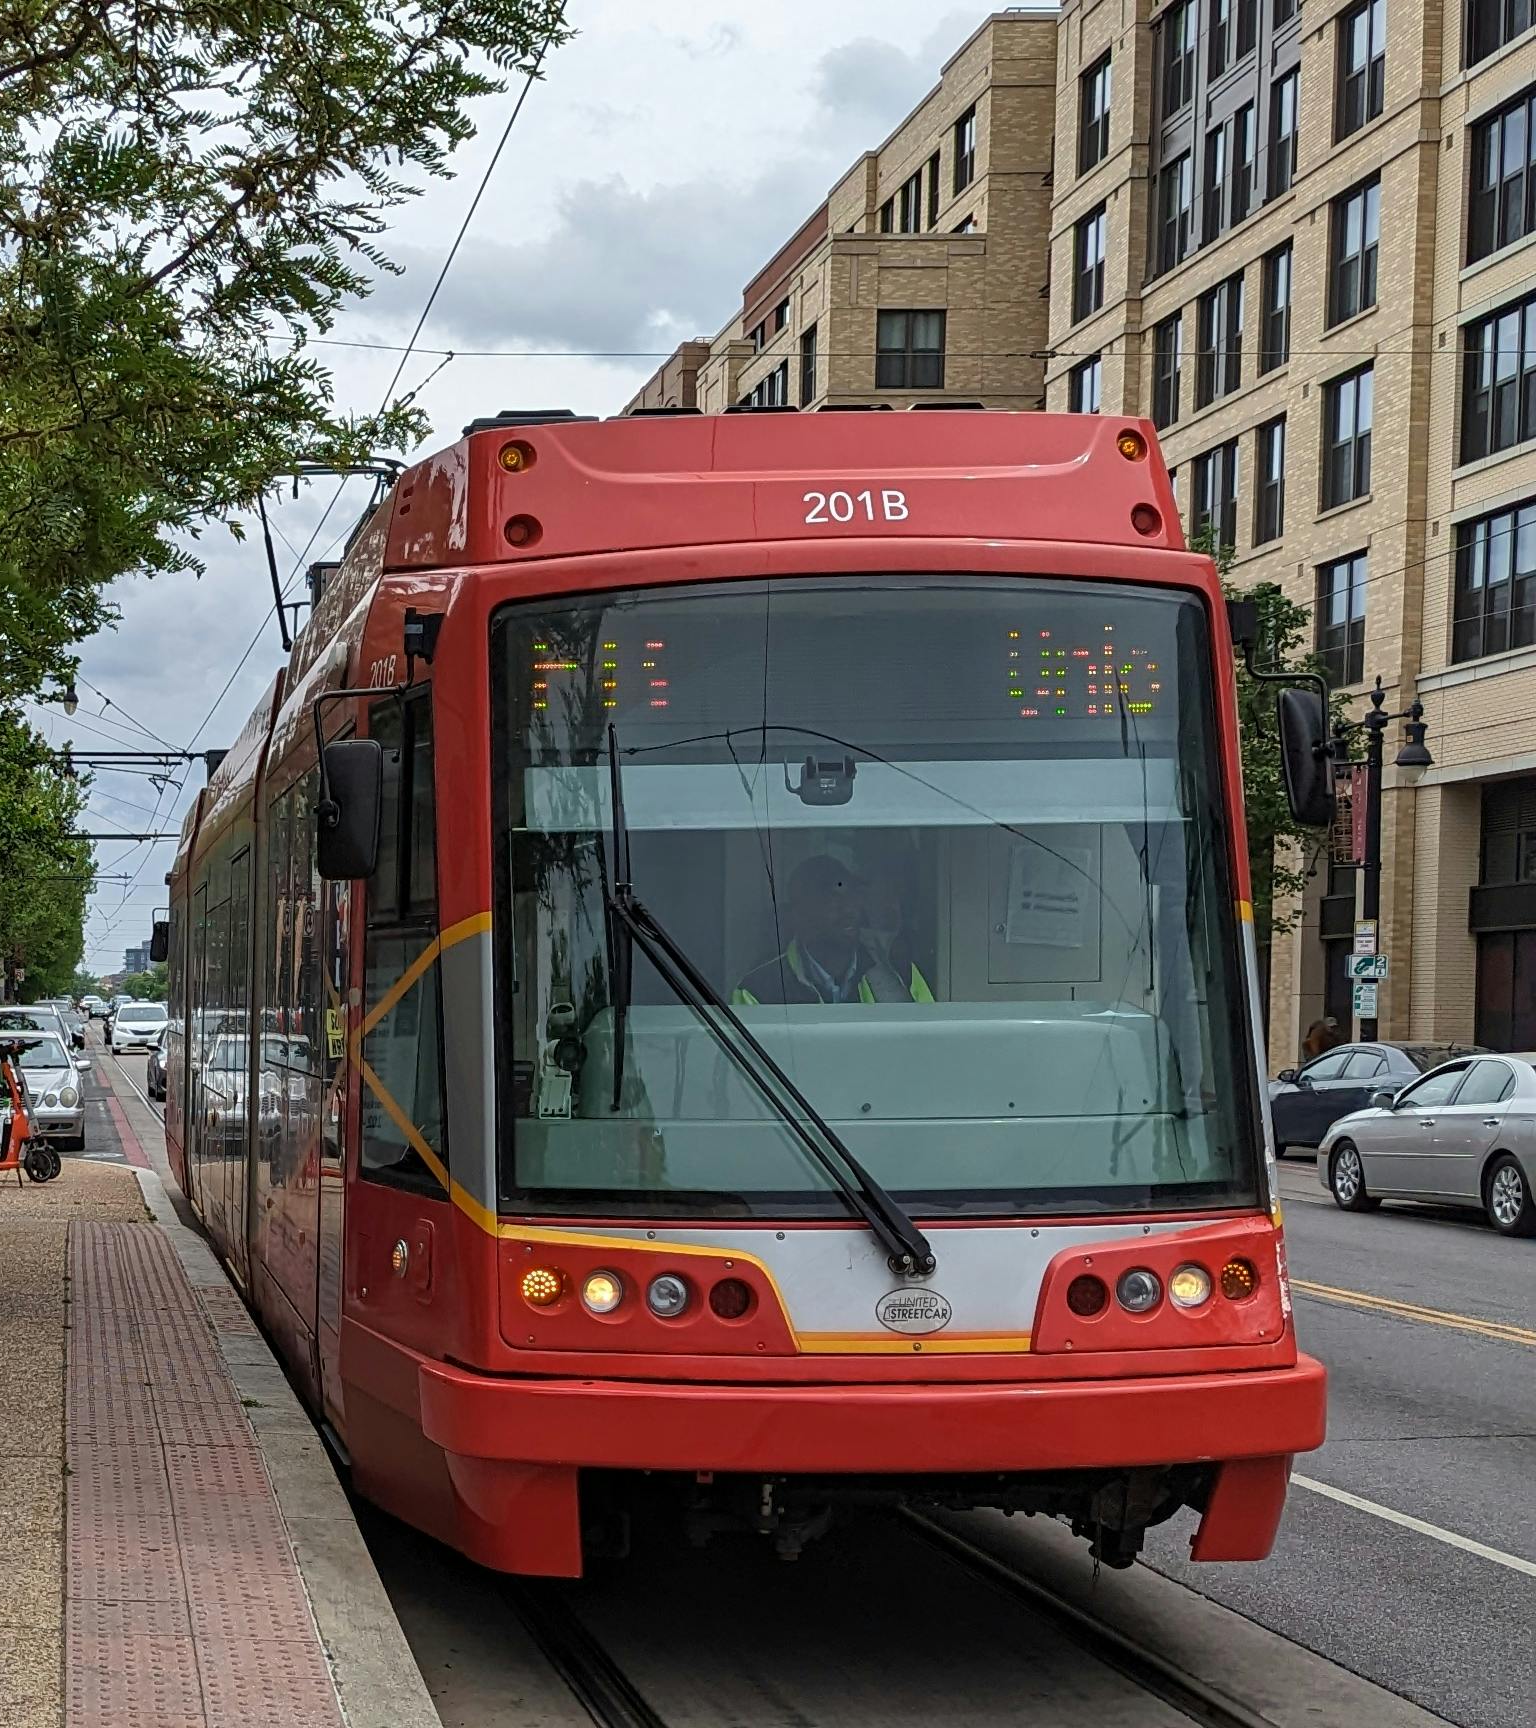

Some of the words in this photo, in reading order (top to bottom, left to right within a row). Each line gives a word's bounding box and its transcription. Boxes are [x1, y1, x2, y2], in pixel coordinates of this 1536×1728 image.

[802, 490, 909, 523] 201B
[369, 654, 397, 689] 201B
[1376, 956, 1385, 968] 2
[898, 1296, 938, 1307] UNITED
[890, 1308, 948, 1319] STREETCAR
